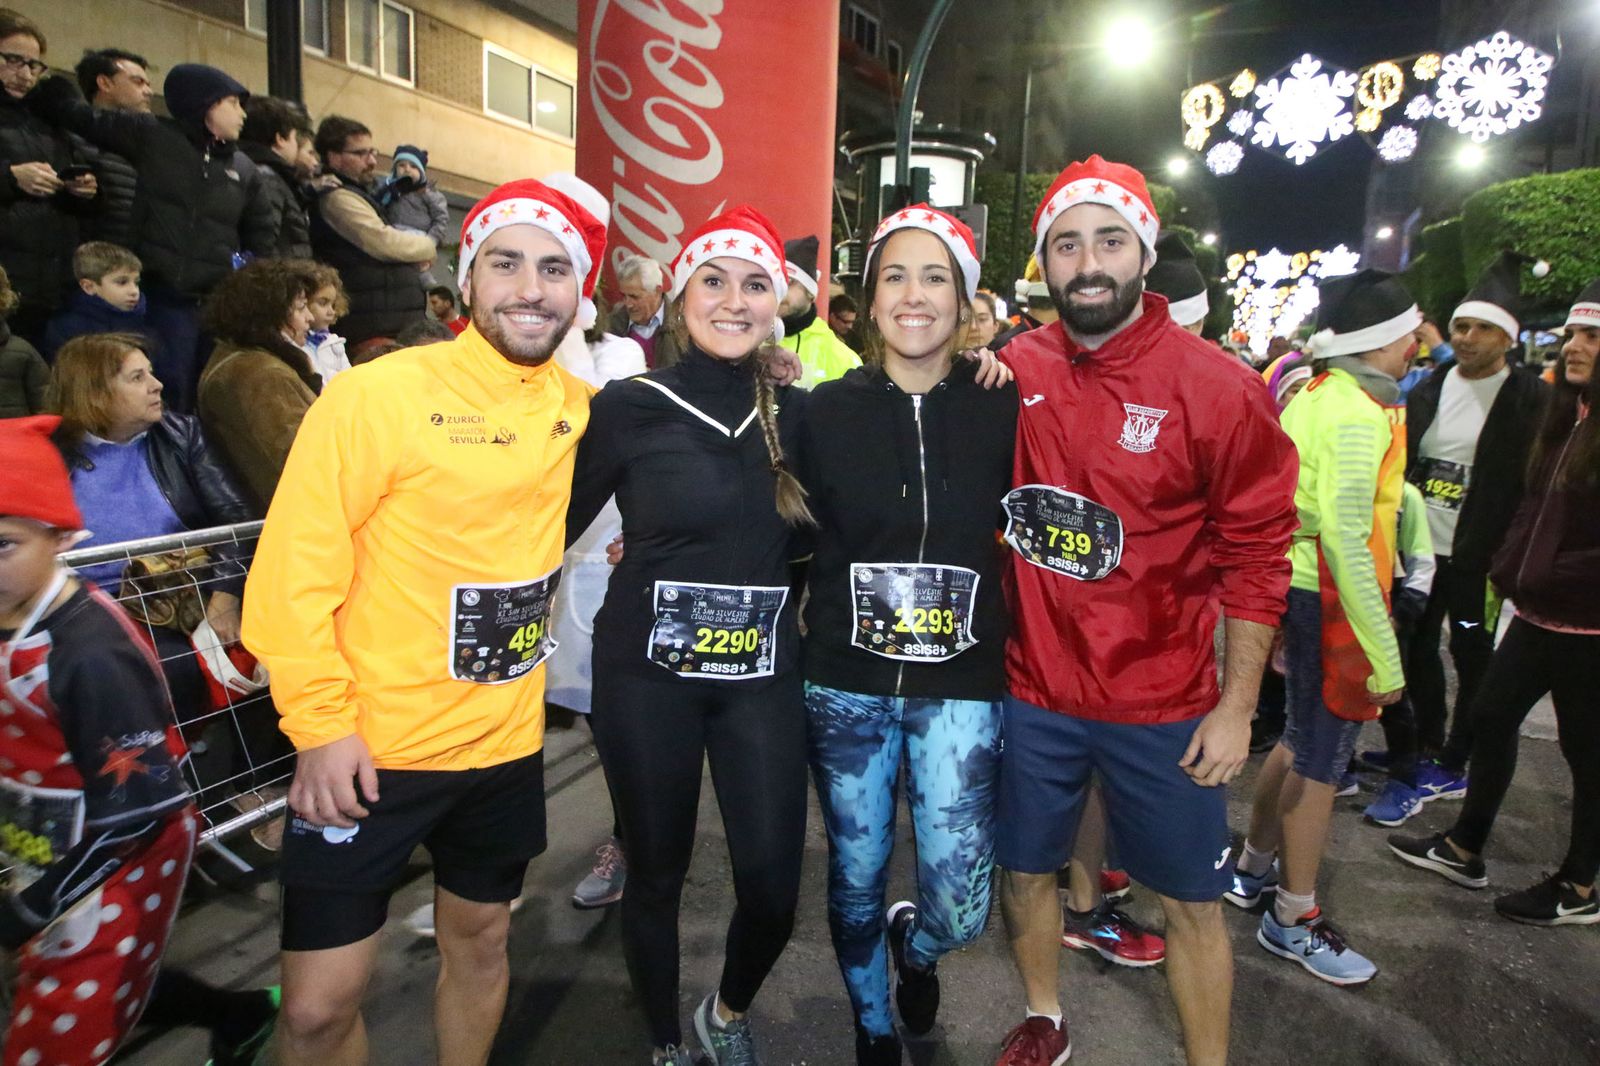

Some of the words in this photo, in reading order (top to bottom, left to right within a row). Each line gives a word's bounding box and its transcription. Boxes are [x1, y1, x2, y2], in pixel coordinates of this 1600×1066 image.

[447, 415, 486, 424] ZURICH
[449, 436, 487, 444] SEVILLA
[1425, 478, 1463, 499] 1922
[1045, 525, 1092, 555] 739
[1061, 552, 1077, 561] PABLO
[690, 613, 714, 622] CIUDAD
[716, 609, 750, 618] SILVESTRE
[894, 608, 954, 635] 2293
[694, 627, 758, 654] 2290
